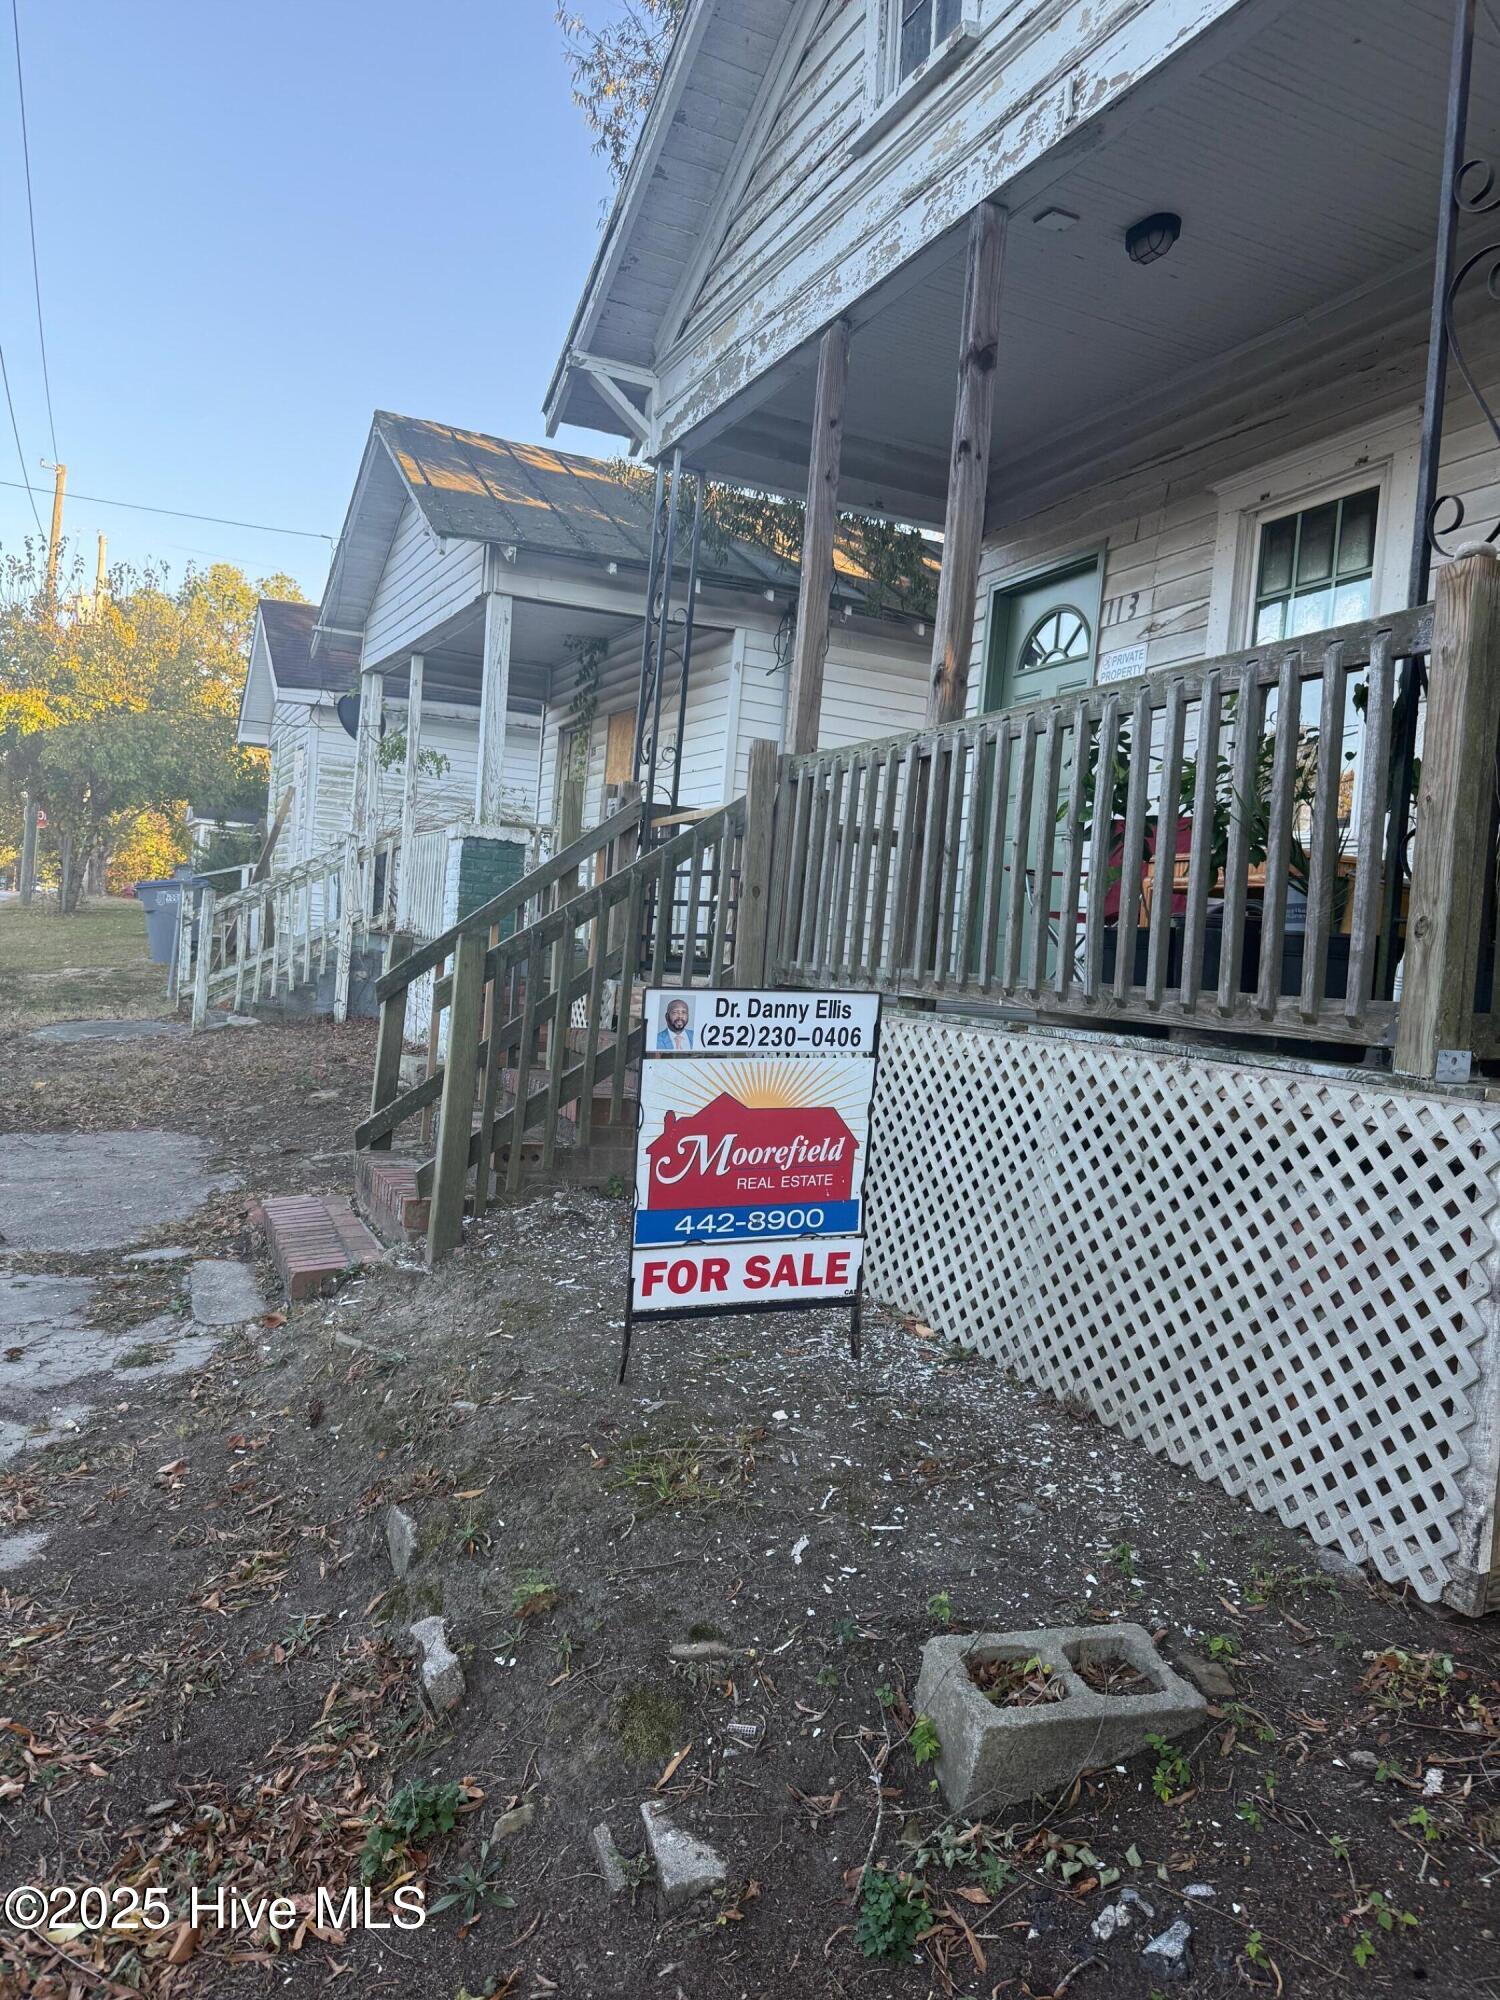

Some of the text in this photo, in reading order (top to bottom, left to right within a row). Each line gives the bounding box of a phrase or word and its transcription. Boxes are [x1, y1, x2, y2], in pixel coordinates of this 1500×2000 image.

[1106, 592, 1140, 625] 113
[1111, 649, 1145, 666] PRIVATE
[1100, 664, 1143, 682] PROPERTY
[715, 997, 852, 1024] Dr. Danny Ellis
[700, 1023, 862, 1047] (252)230-0406
[655, 1133, 846, 1185] Moorefield
[736, 1174, 833, 1190] REAL ESTATE
[674, 1208, 825, 1235] 442-8900
[641, 1251, 852, 1297] FOR SALE
